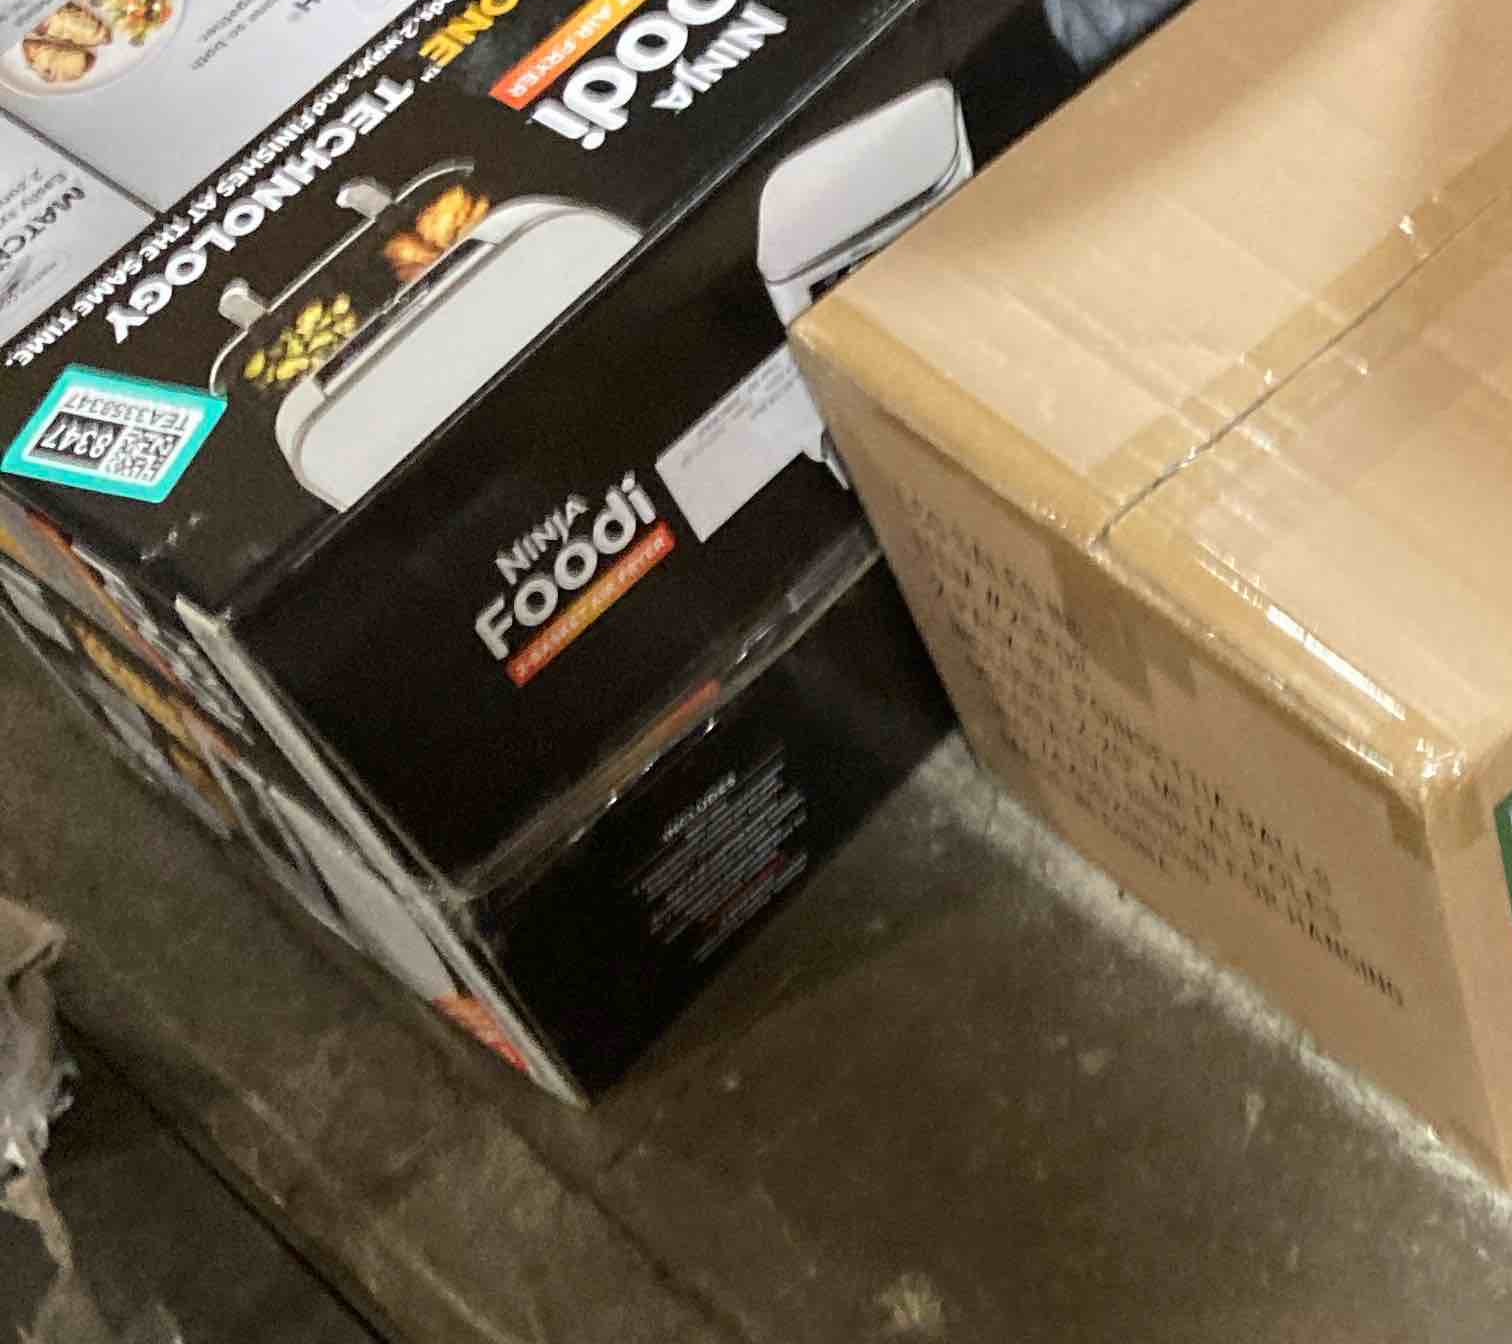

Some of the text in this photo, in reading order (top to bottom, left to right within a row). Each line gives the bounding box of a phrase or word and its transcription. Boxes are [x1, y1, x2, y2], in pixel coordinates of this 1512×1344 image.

[652, 0, 788, 114] NINJA
[308, 77, 354, 119] and
[213, 109, 317, 201] FINISHES
[0, 183, 87, 274] MATC
[107, 78, 415, 344] TECHNOLOGY
[136, 212, 192, 264] THE
[183, 186, 224, 225] AT
[69, 250, 147, 320] SAME
[41, 422, 117, 460] 8347
[494, 492, 589, 586] NINJA
